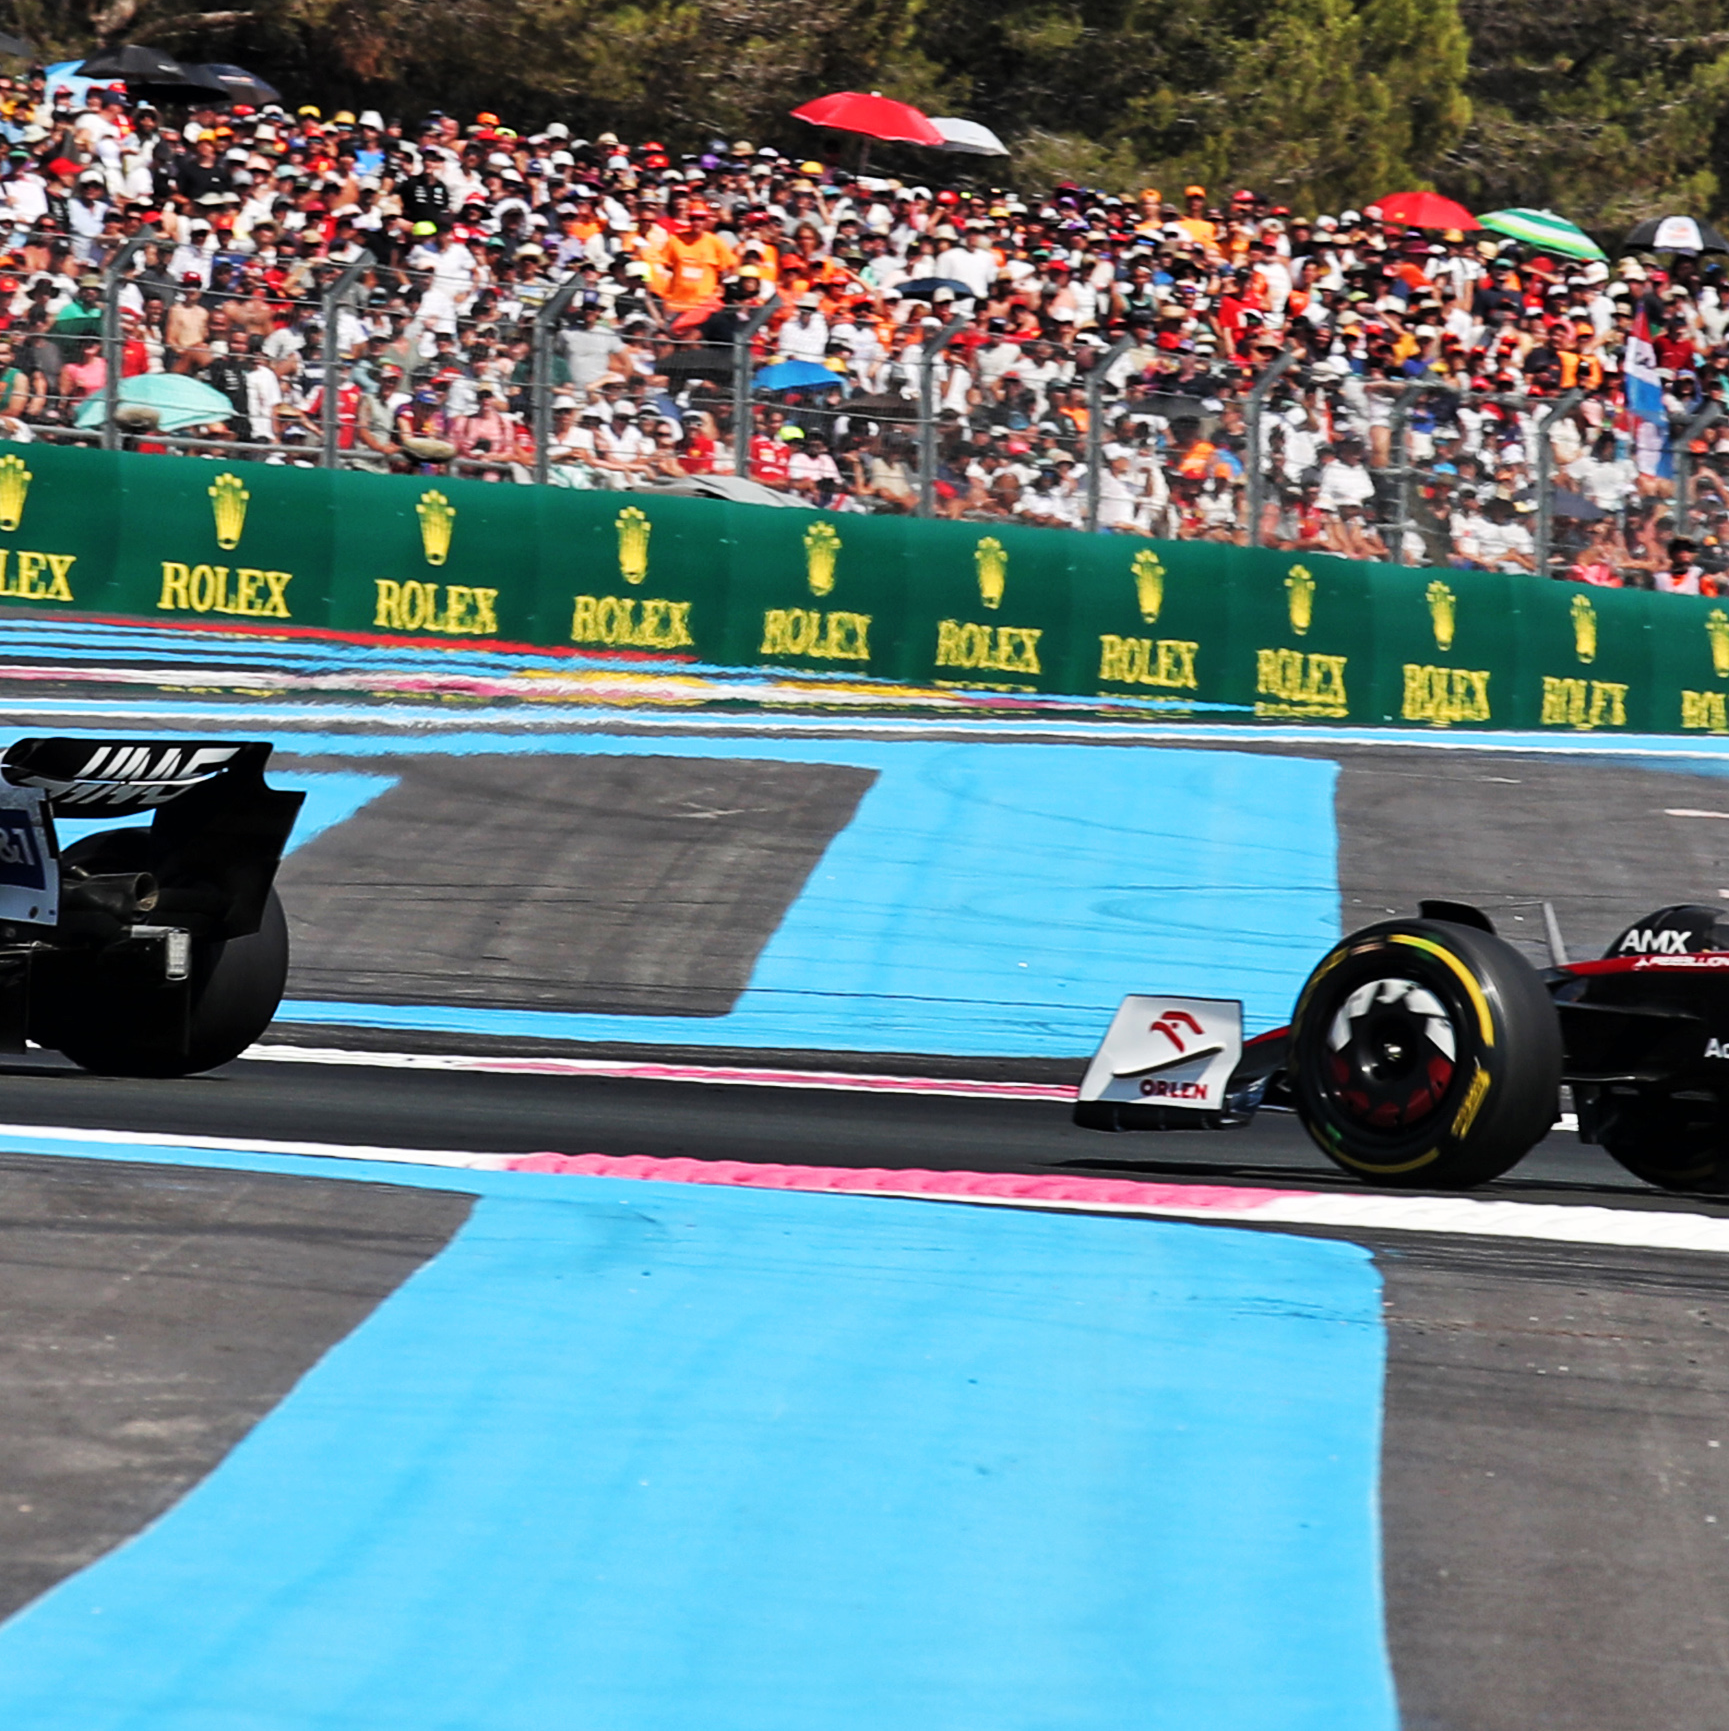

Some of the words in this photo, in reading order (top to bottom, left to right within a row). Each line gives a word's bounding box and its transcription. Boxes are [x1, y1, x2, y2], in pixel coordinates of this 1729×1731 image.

[158, 561, 293, 618] ROLEX
[374, 579, 499, 634] ROLEX
[573, 595, 693, 649] ROLEX
[760, 608, 872, 660] ROLEX
[936, 620, 1042, 674] ROLEX
[1099, 634, 1199, 688] ROLEX
[1618, 928, 1693, 955] AMX
[1139, 1078, 1208, 1101] ORLEN
